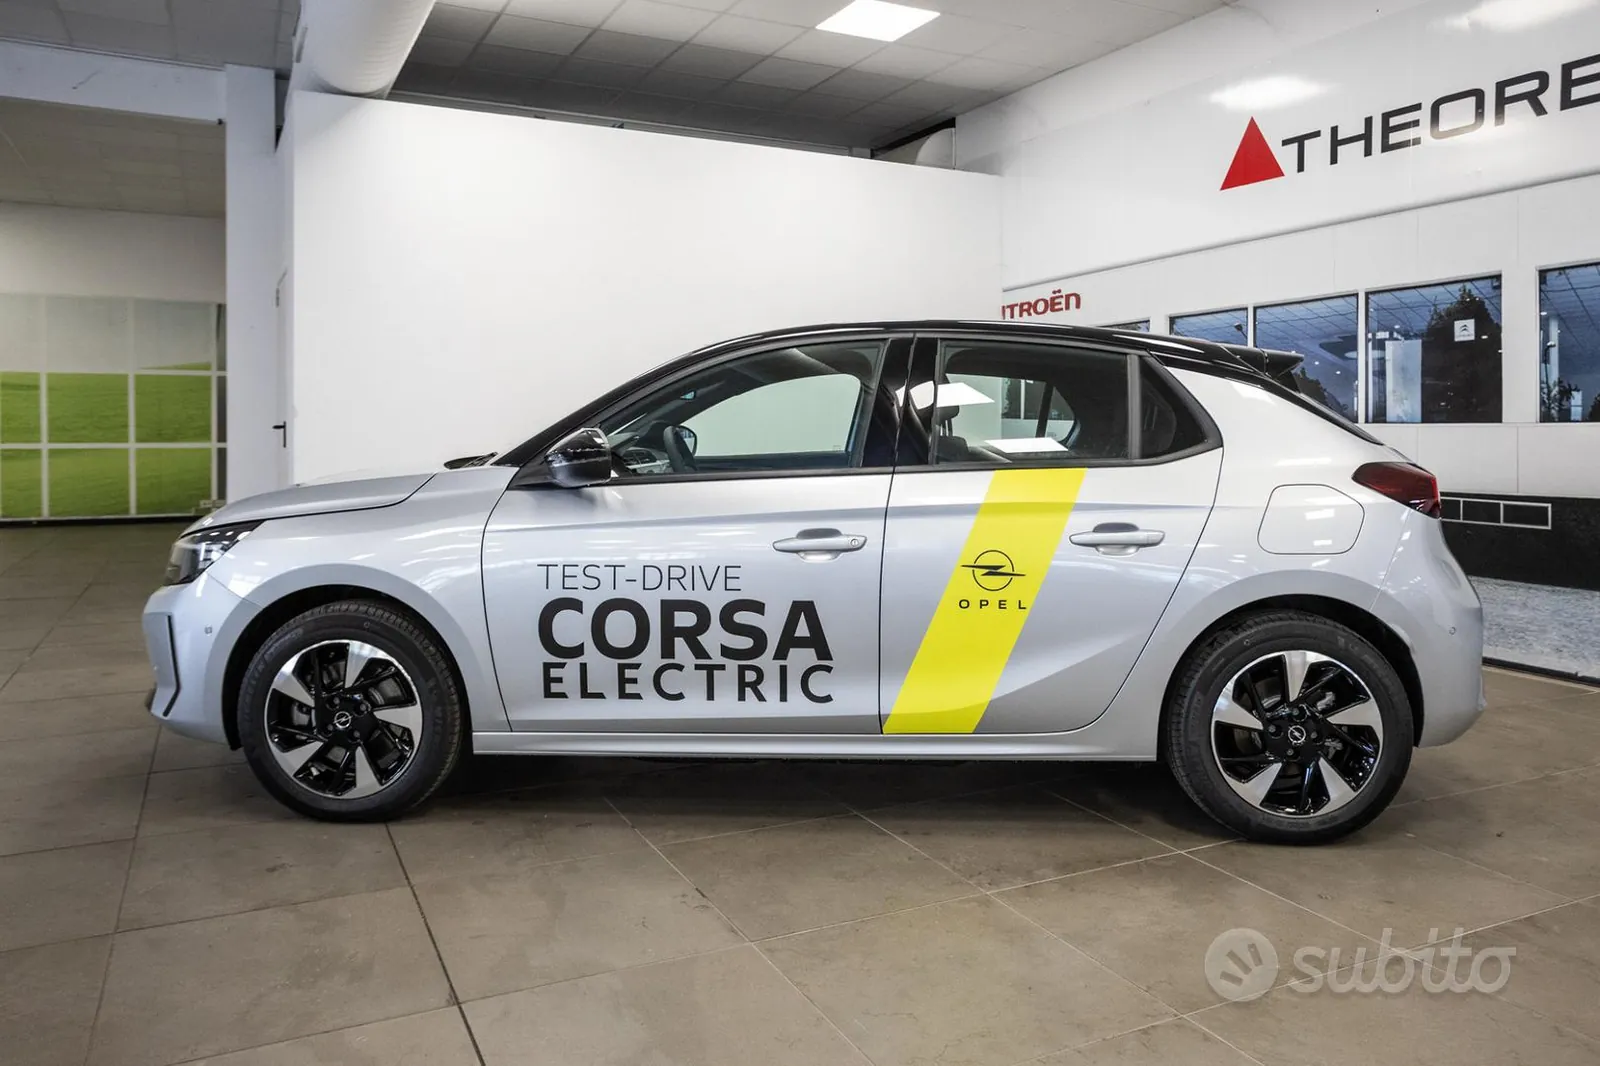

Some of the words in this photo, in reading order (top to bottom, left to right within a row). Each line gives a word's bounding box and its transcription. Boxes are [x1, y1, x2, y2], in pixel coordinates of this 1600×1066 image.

[1281, 54, 1600, 173] THEORE
[537, 563, 742, 591] TEST-DRIVE
[959, 599, 1027, 610] OPEL
[538, 597, 834, 661] CORSA
[542, 662, 834, 703] ELECTRIC
